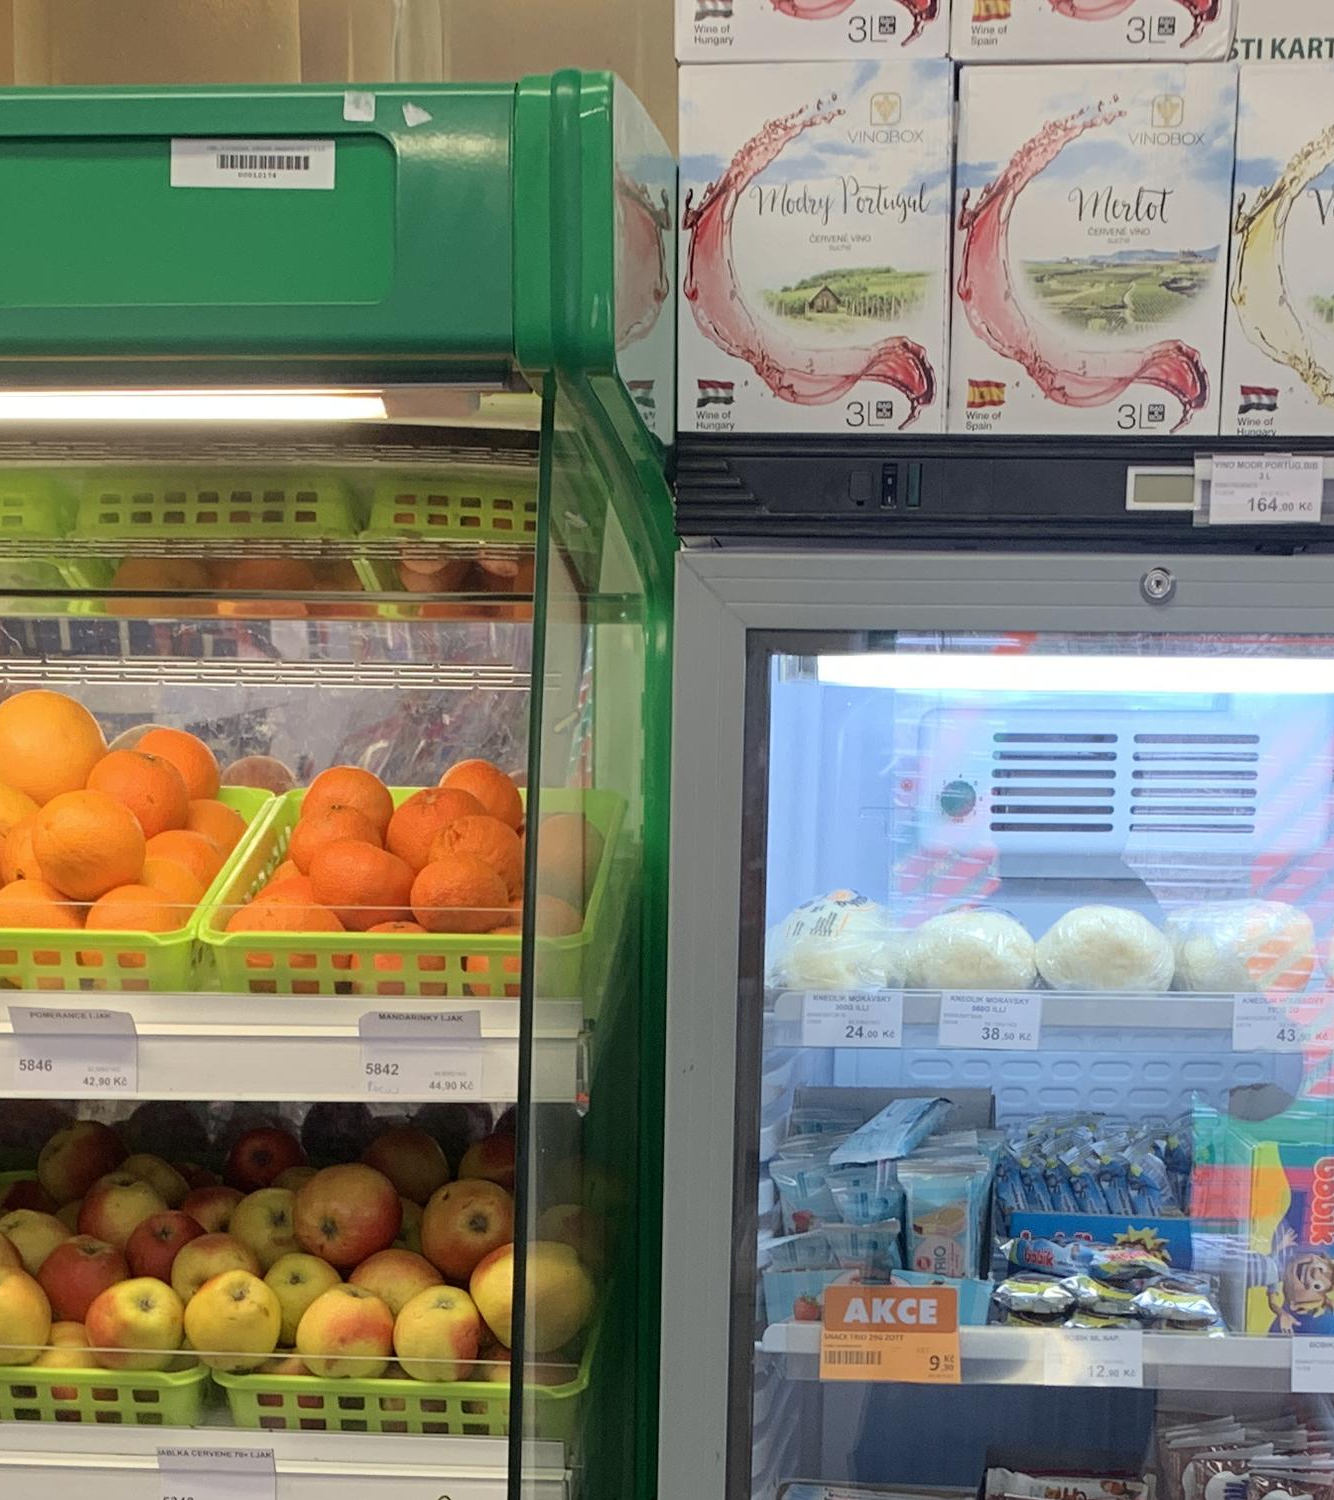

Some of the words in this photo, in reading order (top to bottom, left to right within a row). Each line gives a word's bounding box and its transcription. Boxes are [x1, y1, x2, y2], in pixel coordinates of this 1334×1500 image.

[694, 35, 734, 47] Hungary
[971, 36, 998, 47] Spain
[847, 130, 924, 144] VINOBOX
[1128, 133, 1205, 146] VINOBOX
[835, 175, 930, 226] Portugal
[1068, 186, 1175, 224] Merlot
[18, 1058, 53, 1072] 5846
[365, 1063, 400, 1076] 5842
[843, 1298, 938, 1325] AKCE
[929, 1355, 940, 1371] 9
